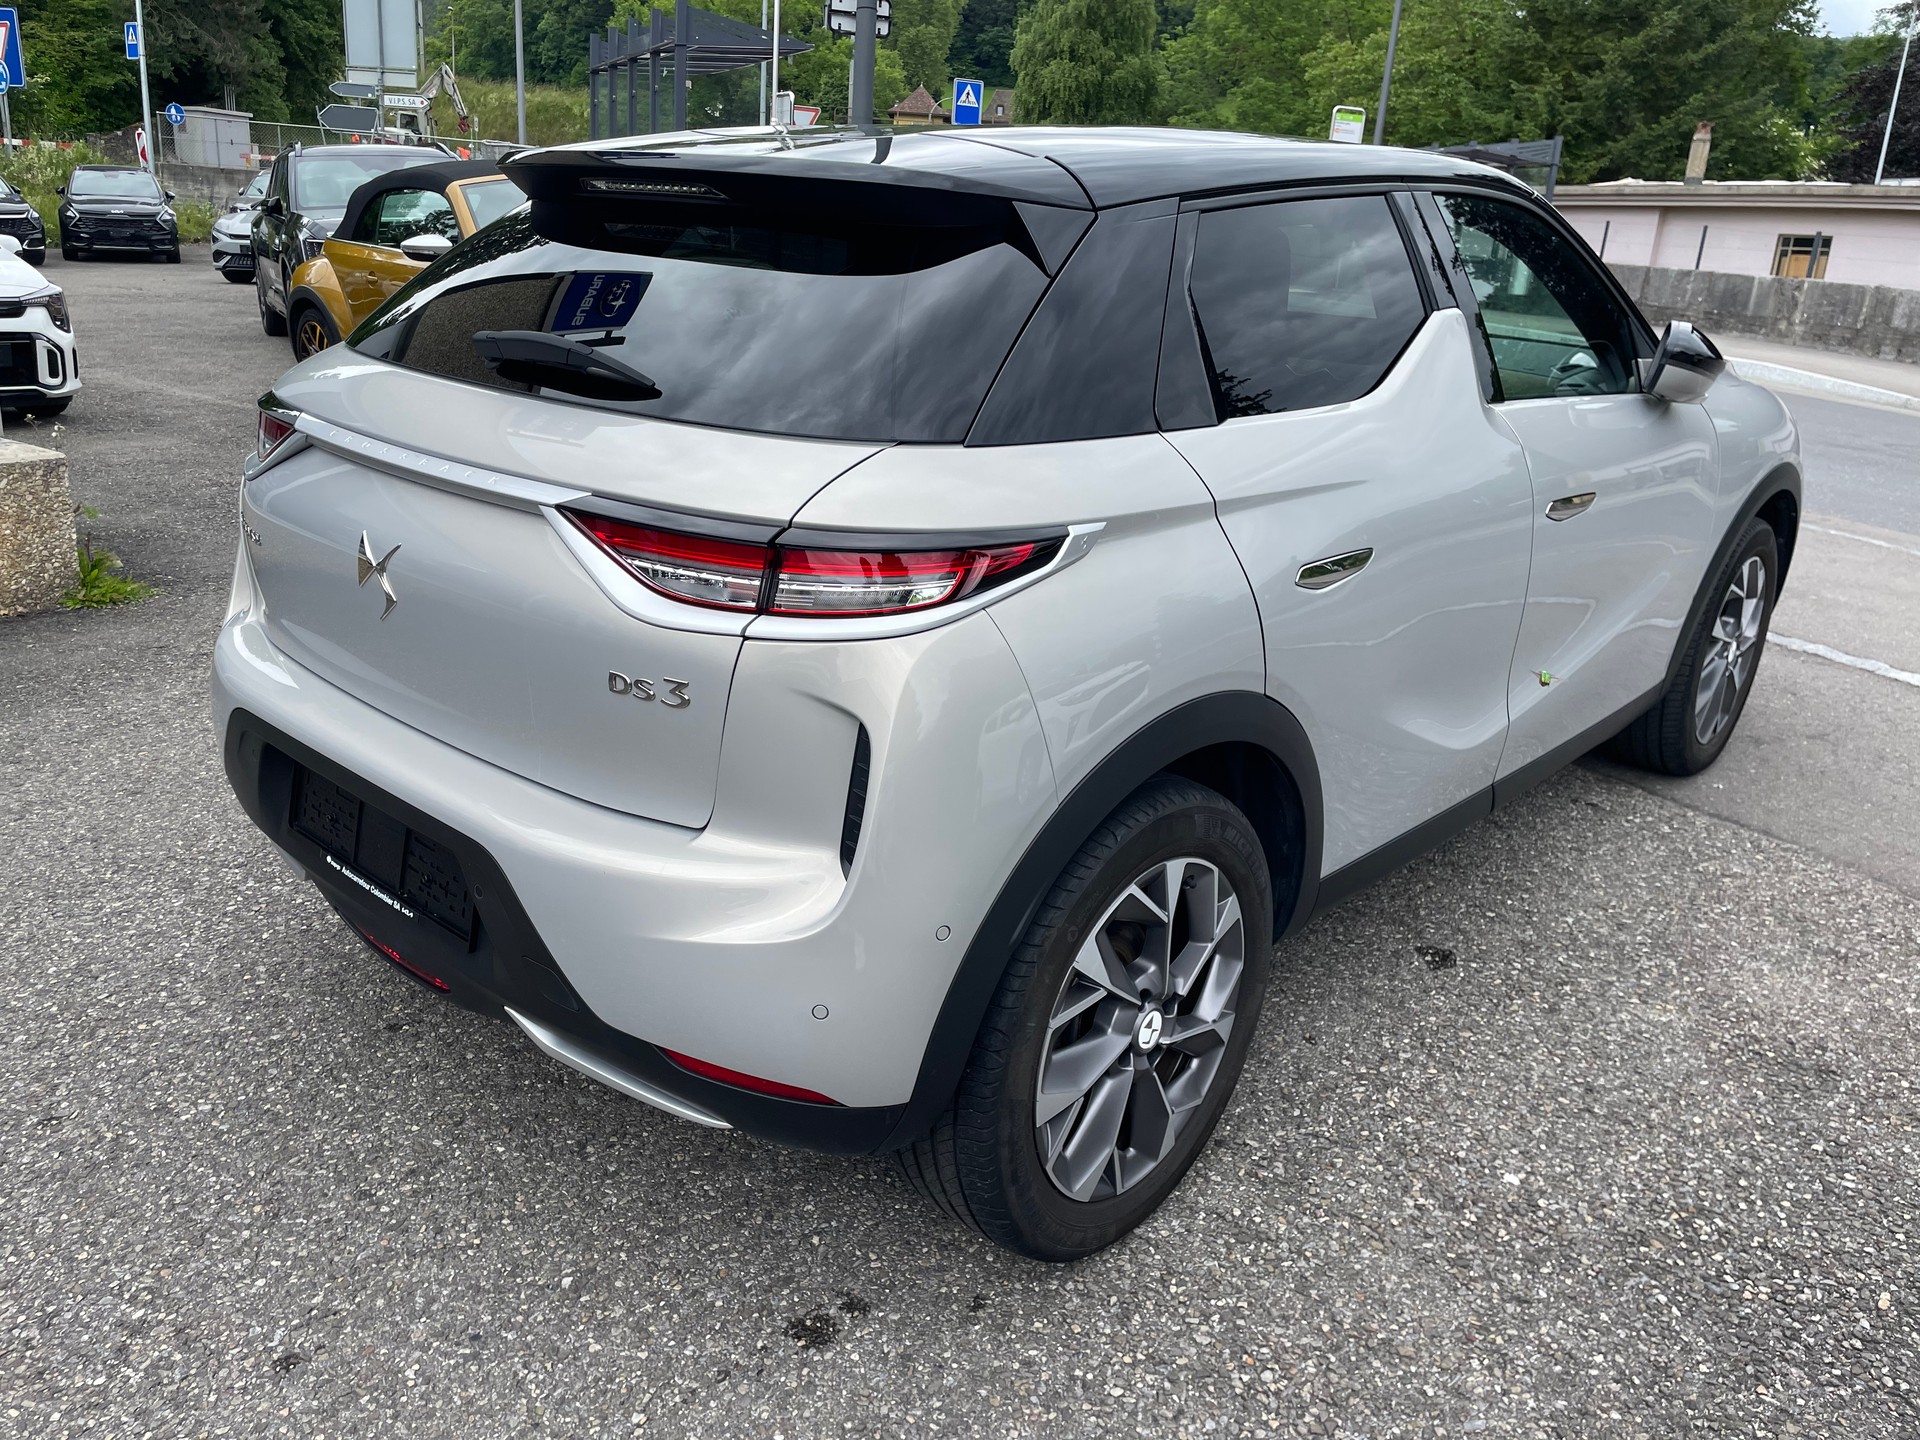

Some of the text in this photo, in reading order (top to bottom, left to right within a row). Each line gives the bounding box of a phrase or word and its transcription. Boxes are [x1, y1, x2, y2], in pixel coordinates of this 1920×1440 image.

[408, 98, 416, 106] SA
[660, 676, 691, 709] 3
[370, 885, 394, 906] Colombier
[393, 900, 401, 911] SA
